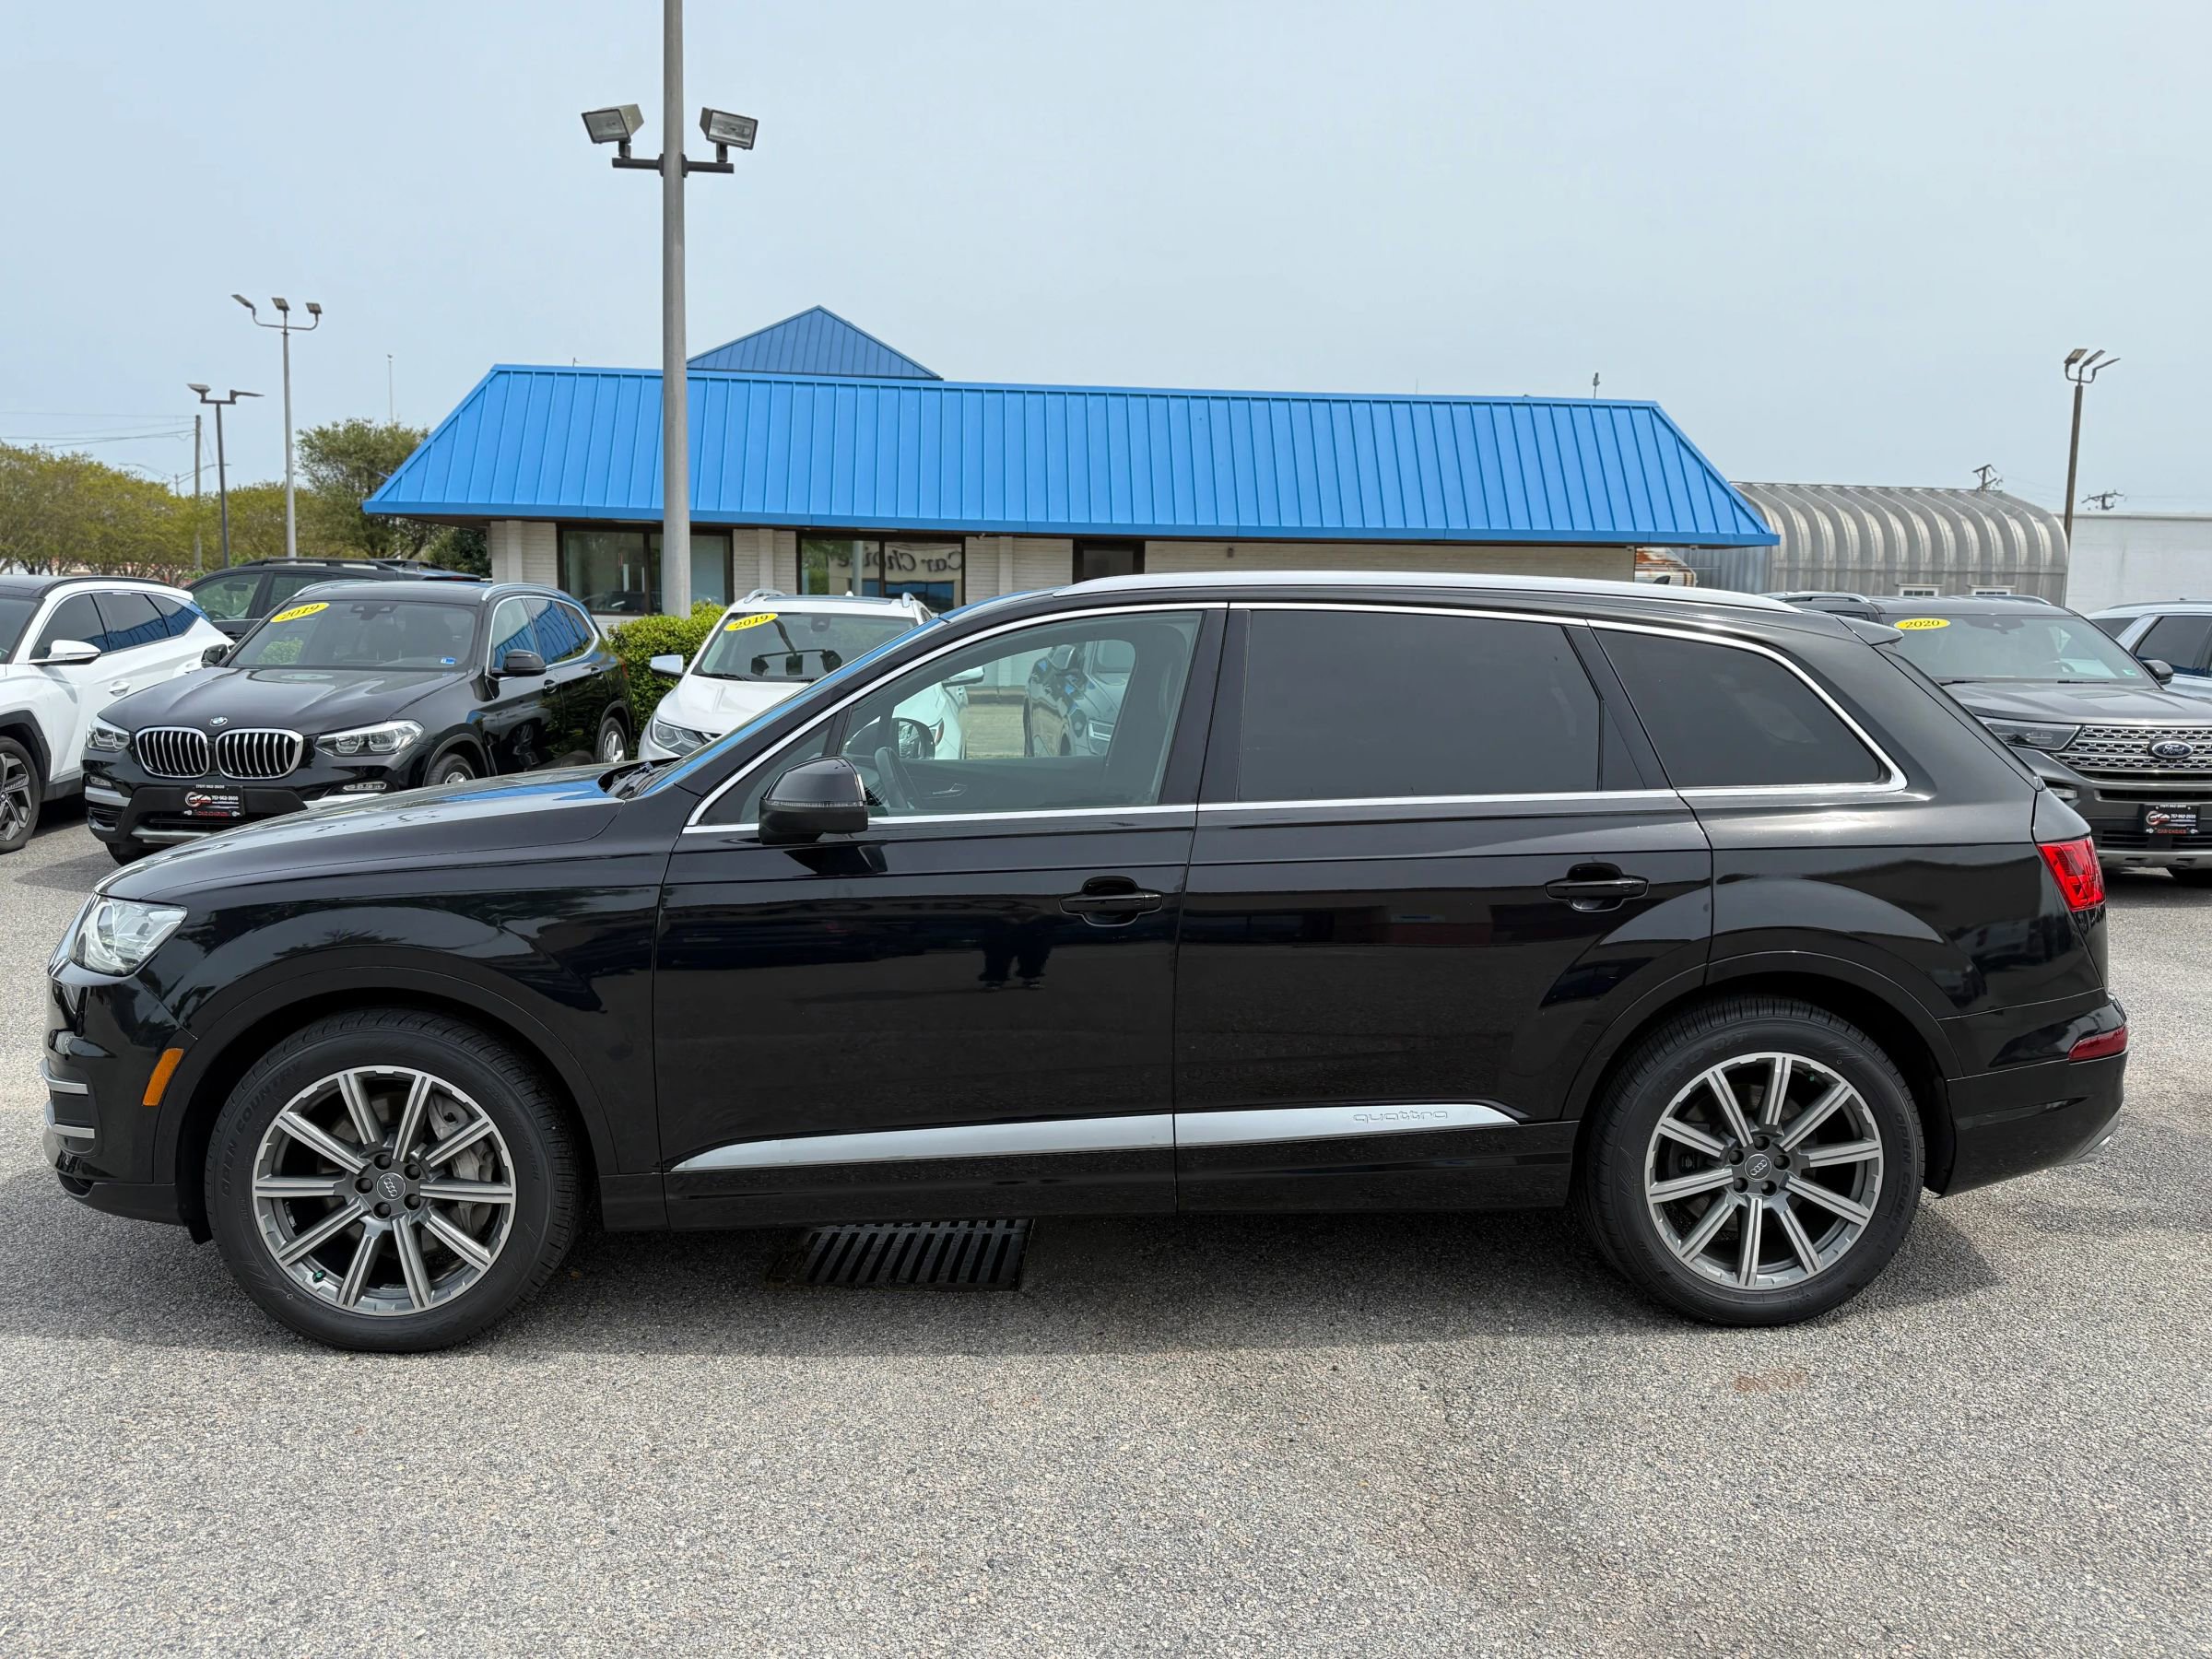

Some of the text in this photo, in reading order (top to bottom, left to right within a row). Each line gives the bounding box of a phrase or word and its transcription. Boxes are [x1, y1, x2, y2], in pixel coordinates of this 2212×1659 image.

[280, 605, 320, 619] 2019
[735, 615, 769, 629] 2019
[1905, 620, 1940, 629] 2020
[1353, 1110, 1448, 1124] quattro
